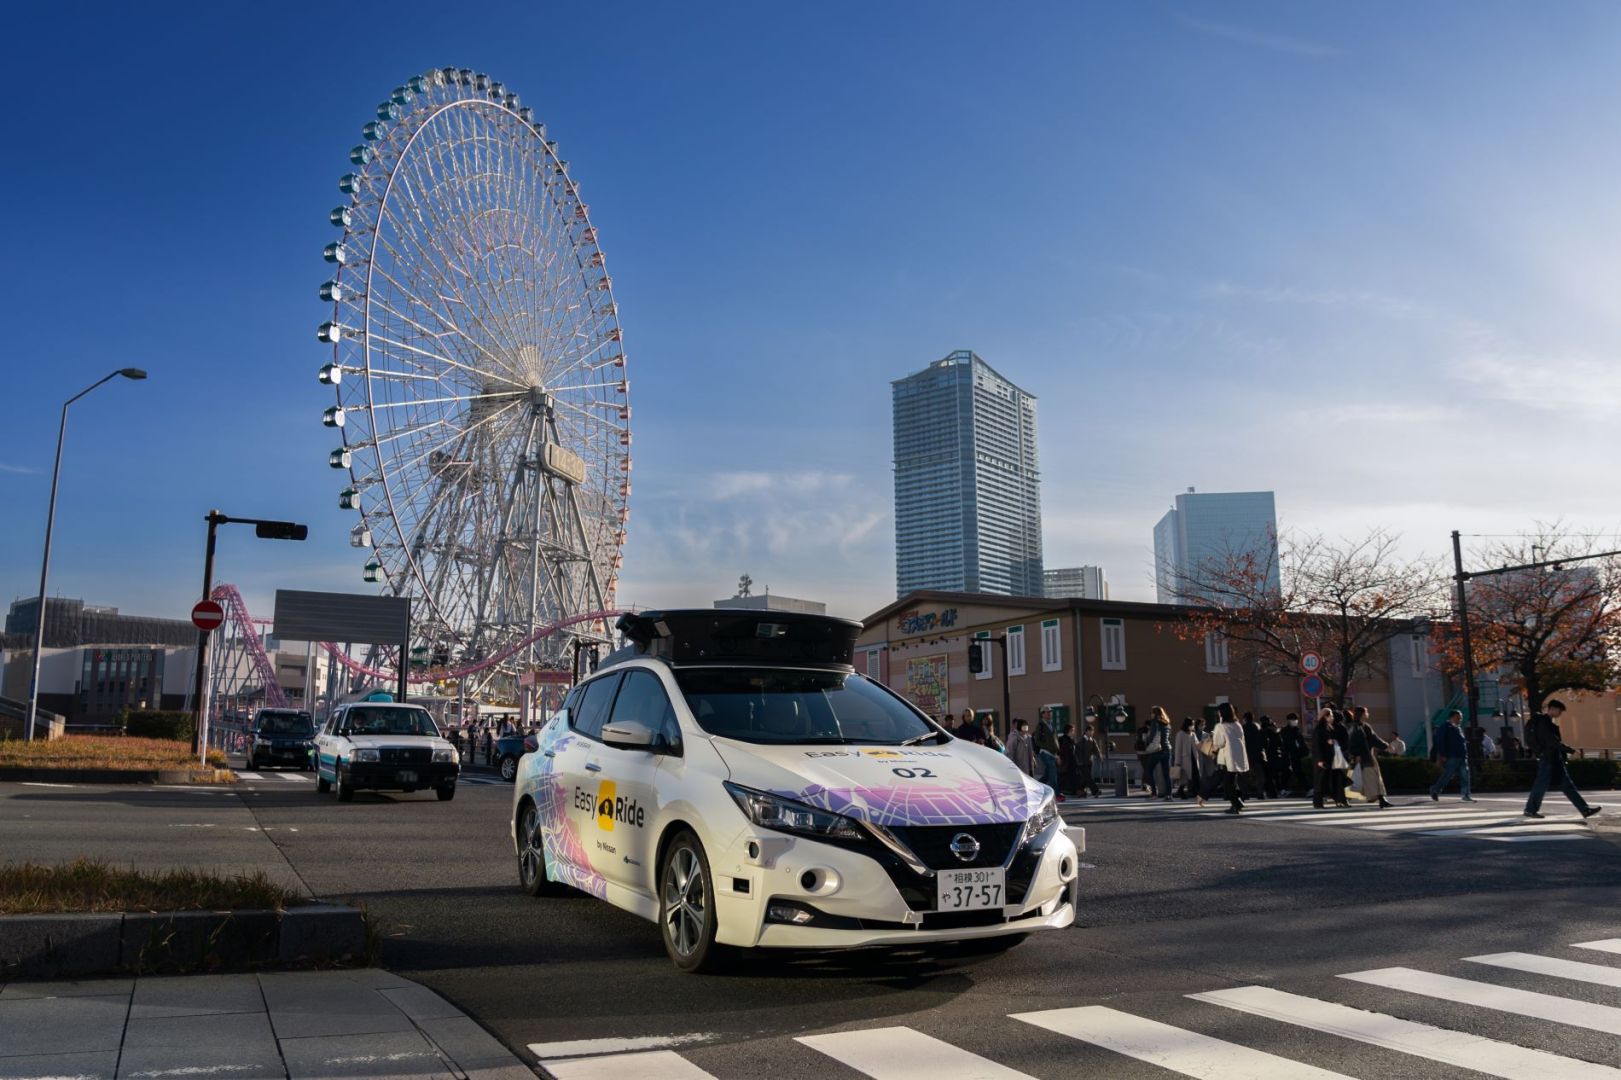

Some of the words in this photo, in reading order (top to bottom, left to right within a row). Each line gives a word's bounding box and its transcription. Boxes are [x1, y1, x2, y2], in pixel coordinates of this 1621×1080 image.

[1305, 656, 1317, 667] 40
[892, 767, 938, 778] 02
[574, 786, 598, 820] Easy
[615, 796, 644, 828] Ride
[942, 892, 951, 904] や
[953, 885, 1001, 908] 37-57
